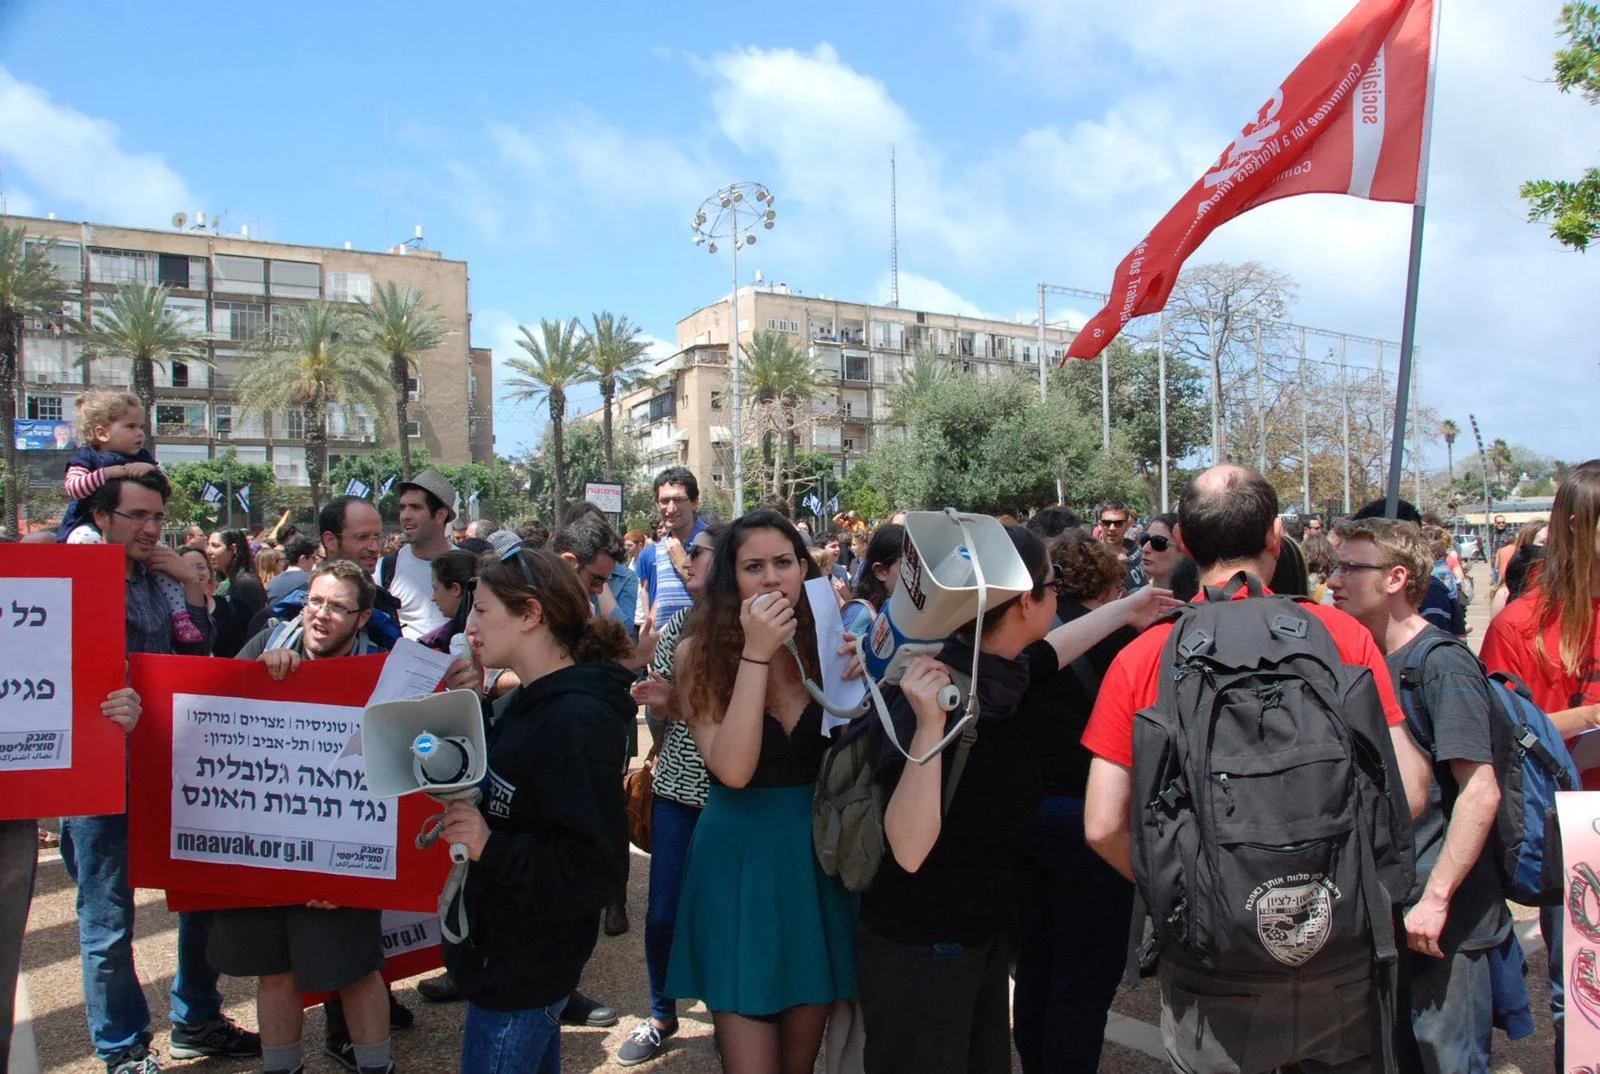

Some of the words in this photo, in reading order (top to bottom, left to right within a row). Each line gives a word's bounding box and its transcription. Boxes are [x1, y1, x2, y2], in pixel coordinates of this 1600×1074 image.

[1129, 256, 1145, 276] los
[11, 600, 47, 628] כל
[193, 710, 230, 725] מרוקו
[240, 714, 284, 729] מצריים
[295, 719, 347, 733] טוניסיה
[26, 732, 56, 743] מאבק
[204, 731, 245, 747] לונדון:
[253, 736, 309, 751] תל-אביב
[196, 753, 290, 784] גלובלית
[181, 783, 256, 811] האונס
[263, 791, 342, 819] תרבות
[349, 799, 387, 822] נגד
[177, 832, 314, 862] maavak.org.il
[360, 845, 384, 855] מאבק
[1263, 876, 1285, 889] אותך
[1244, 886, 1264, 911] באהבה
